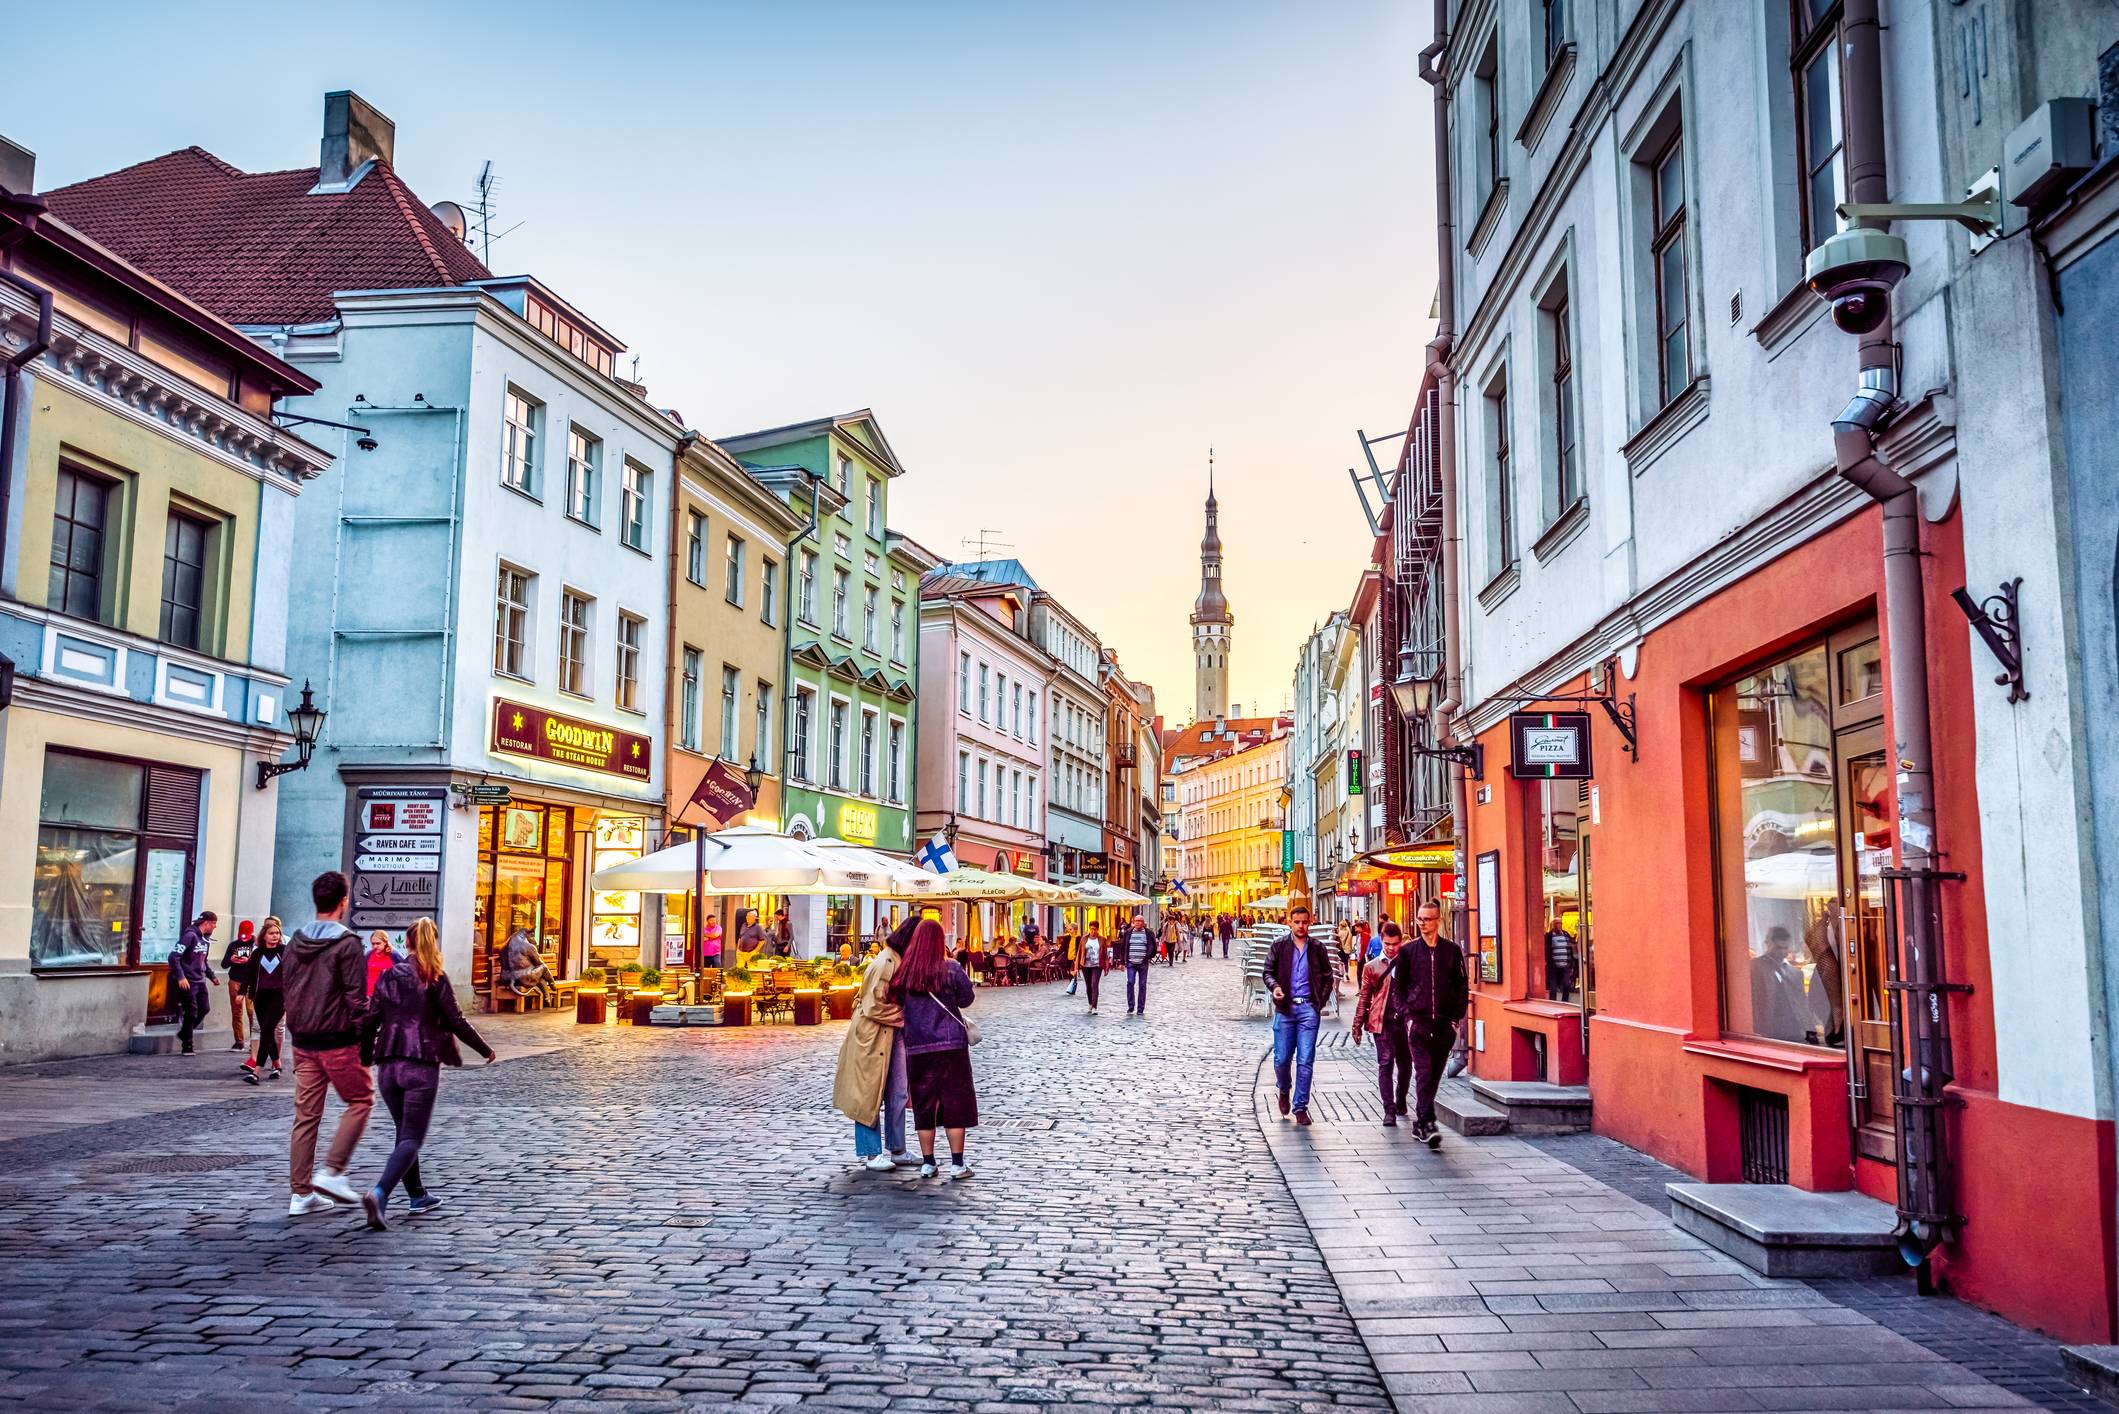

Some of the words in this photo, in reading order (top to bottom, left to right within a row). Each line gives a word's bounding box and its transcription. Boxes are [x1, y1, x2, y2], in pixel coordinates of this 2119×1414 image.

[545, 717, 614, 754] GOODWIN
[501, 737, 533, 751] RESTORAN
[552, 748, 564, 759] THE
[565, 751, 585, 763] STEAK
[586, 756, 606, 767] HOUSE
[623, 764, 647, 776] RESTORAN
[372, 789, 408, 797] MÜÜRIVAHE
[709, 780, 743, 806] GOODWIN
[376, 839, 398, 848] RAVEN
[399, 839, 416, 848] CAFE
